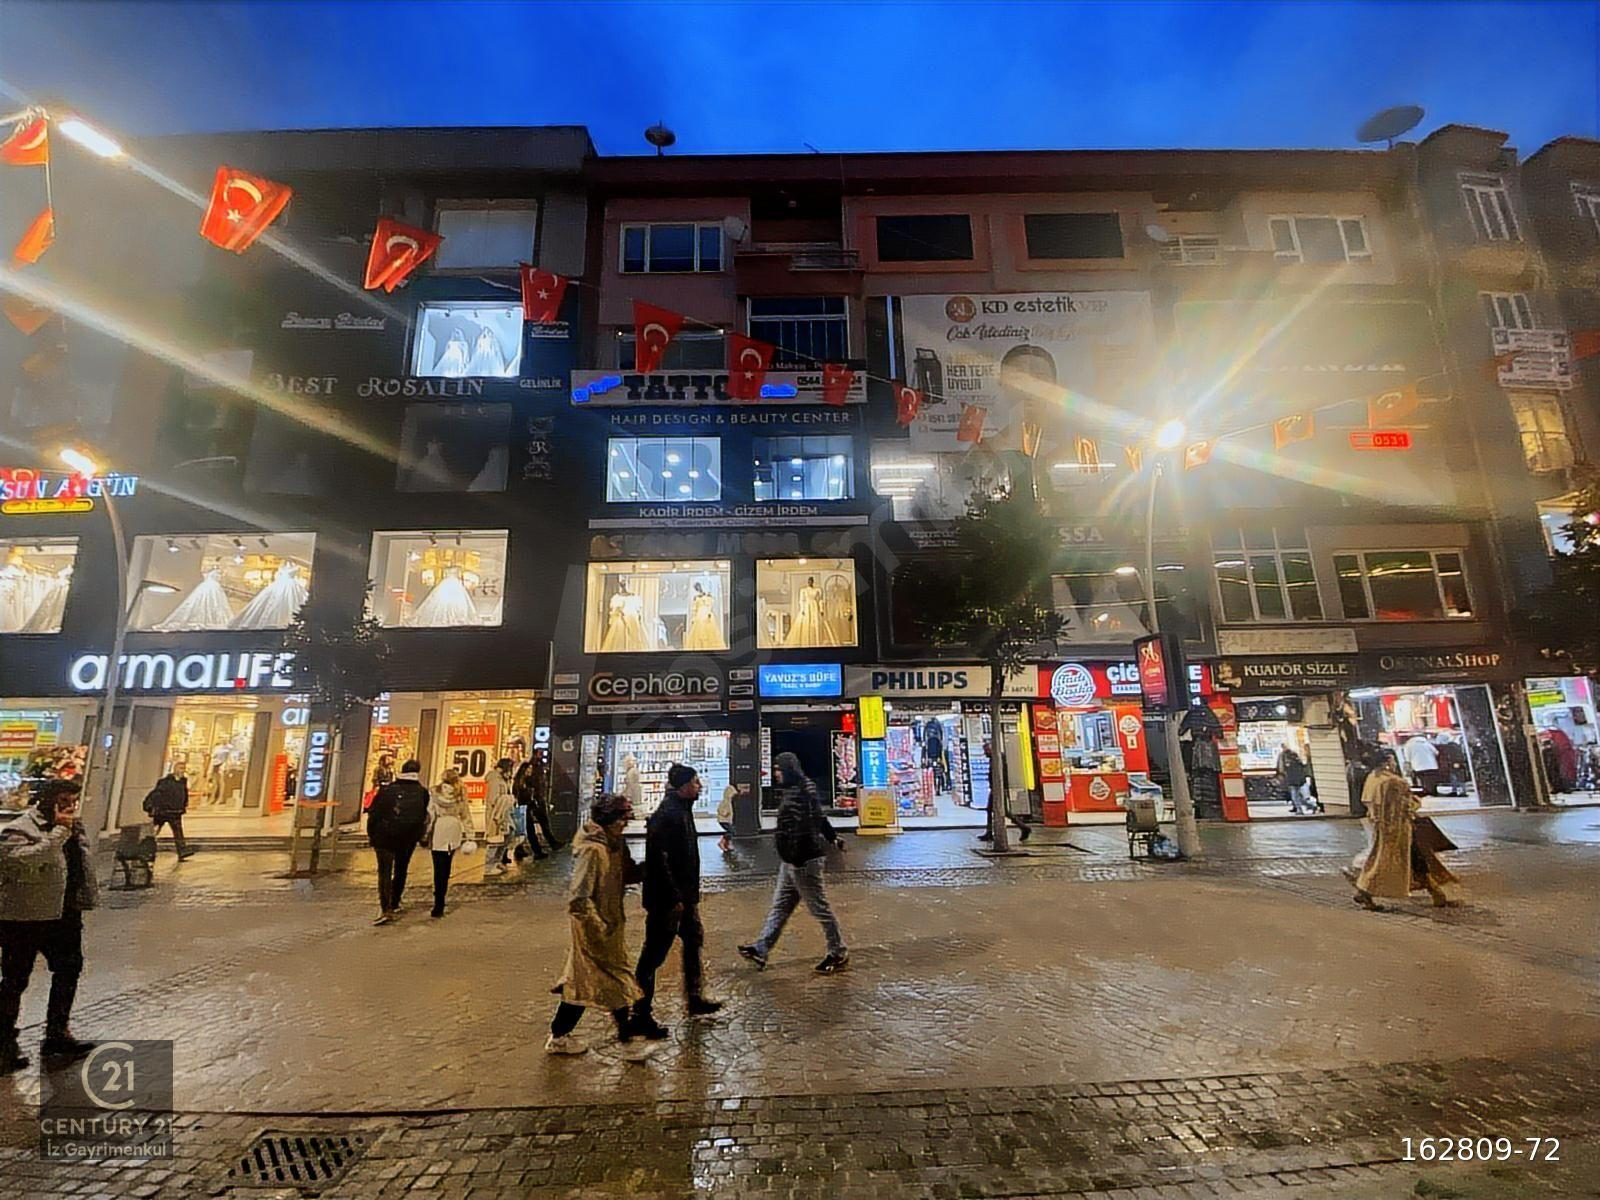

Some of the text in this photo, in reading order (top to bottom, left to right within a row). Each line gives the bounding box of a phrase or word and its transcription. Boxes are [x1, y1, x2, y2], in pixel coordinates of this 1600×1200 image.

[982, 300, 1008, 313] KD
[1013, 296, 1077, 313] estetik
[357, 377, 484, 397] ROSALIN
[622, 375, 731, 400] TATTO
[611, 412, 850, 425] HAIR DESIGN & BEAUTY CENTER
[639, 507, 679, 518] KADİR
[682, 506, 723, 517] İRDEM
[735, 506, 774, 517] GİZEM
[777, 505, 818, 516] İRDEM
[764, 669, 837, 683] YAVUZ'S BÜFE
[871, 671, 968, 690] PHILIPS
[304, 732, 329, 798] arma
[453, 749, 487, 777] 50
